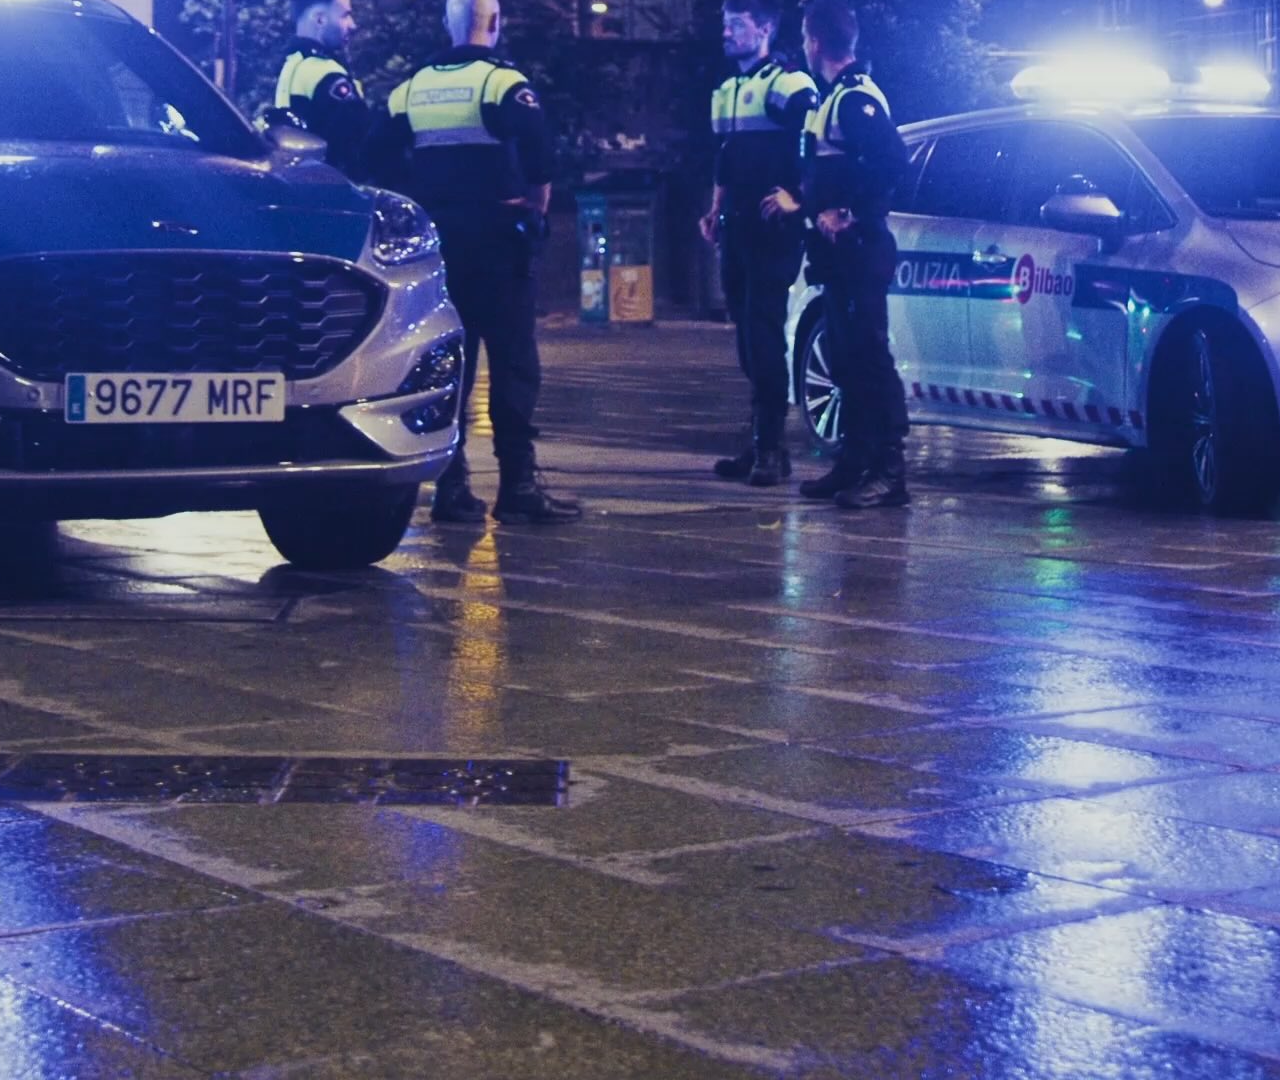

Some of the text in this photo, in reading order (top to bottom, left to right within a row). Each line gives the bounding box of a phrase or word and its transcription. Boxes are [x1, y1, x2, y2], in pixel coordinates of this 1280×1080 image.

[894, 259, 962, 291] OLIZIA
[1019, 265, 1073, 297] Bilbao
[72, 403, 81, 414] E
[95, 379, 277, 416] 9677 MRF
